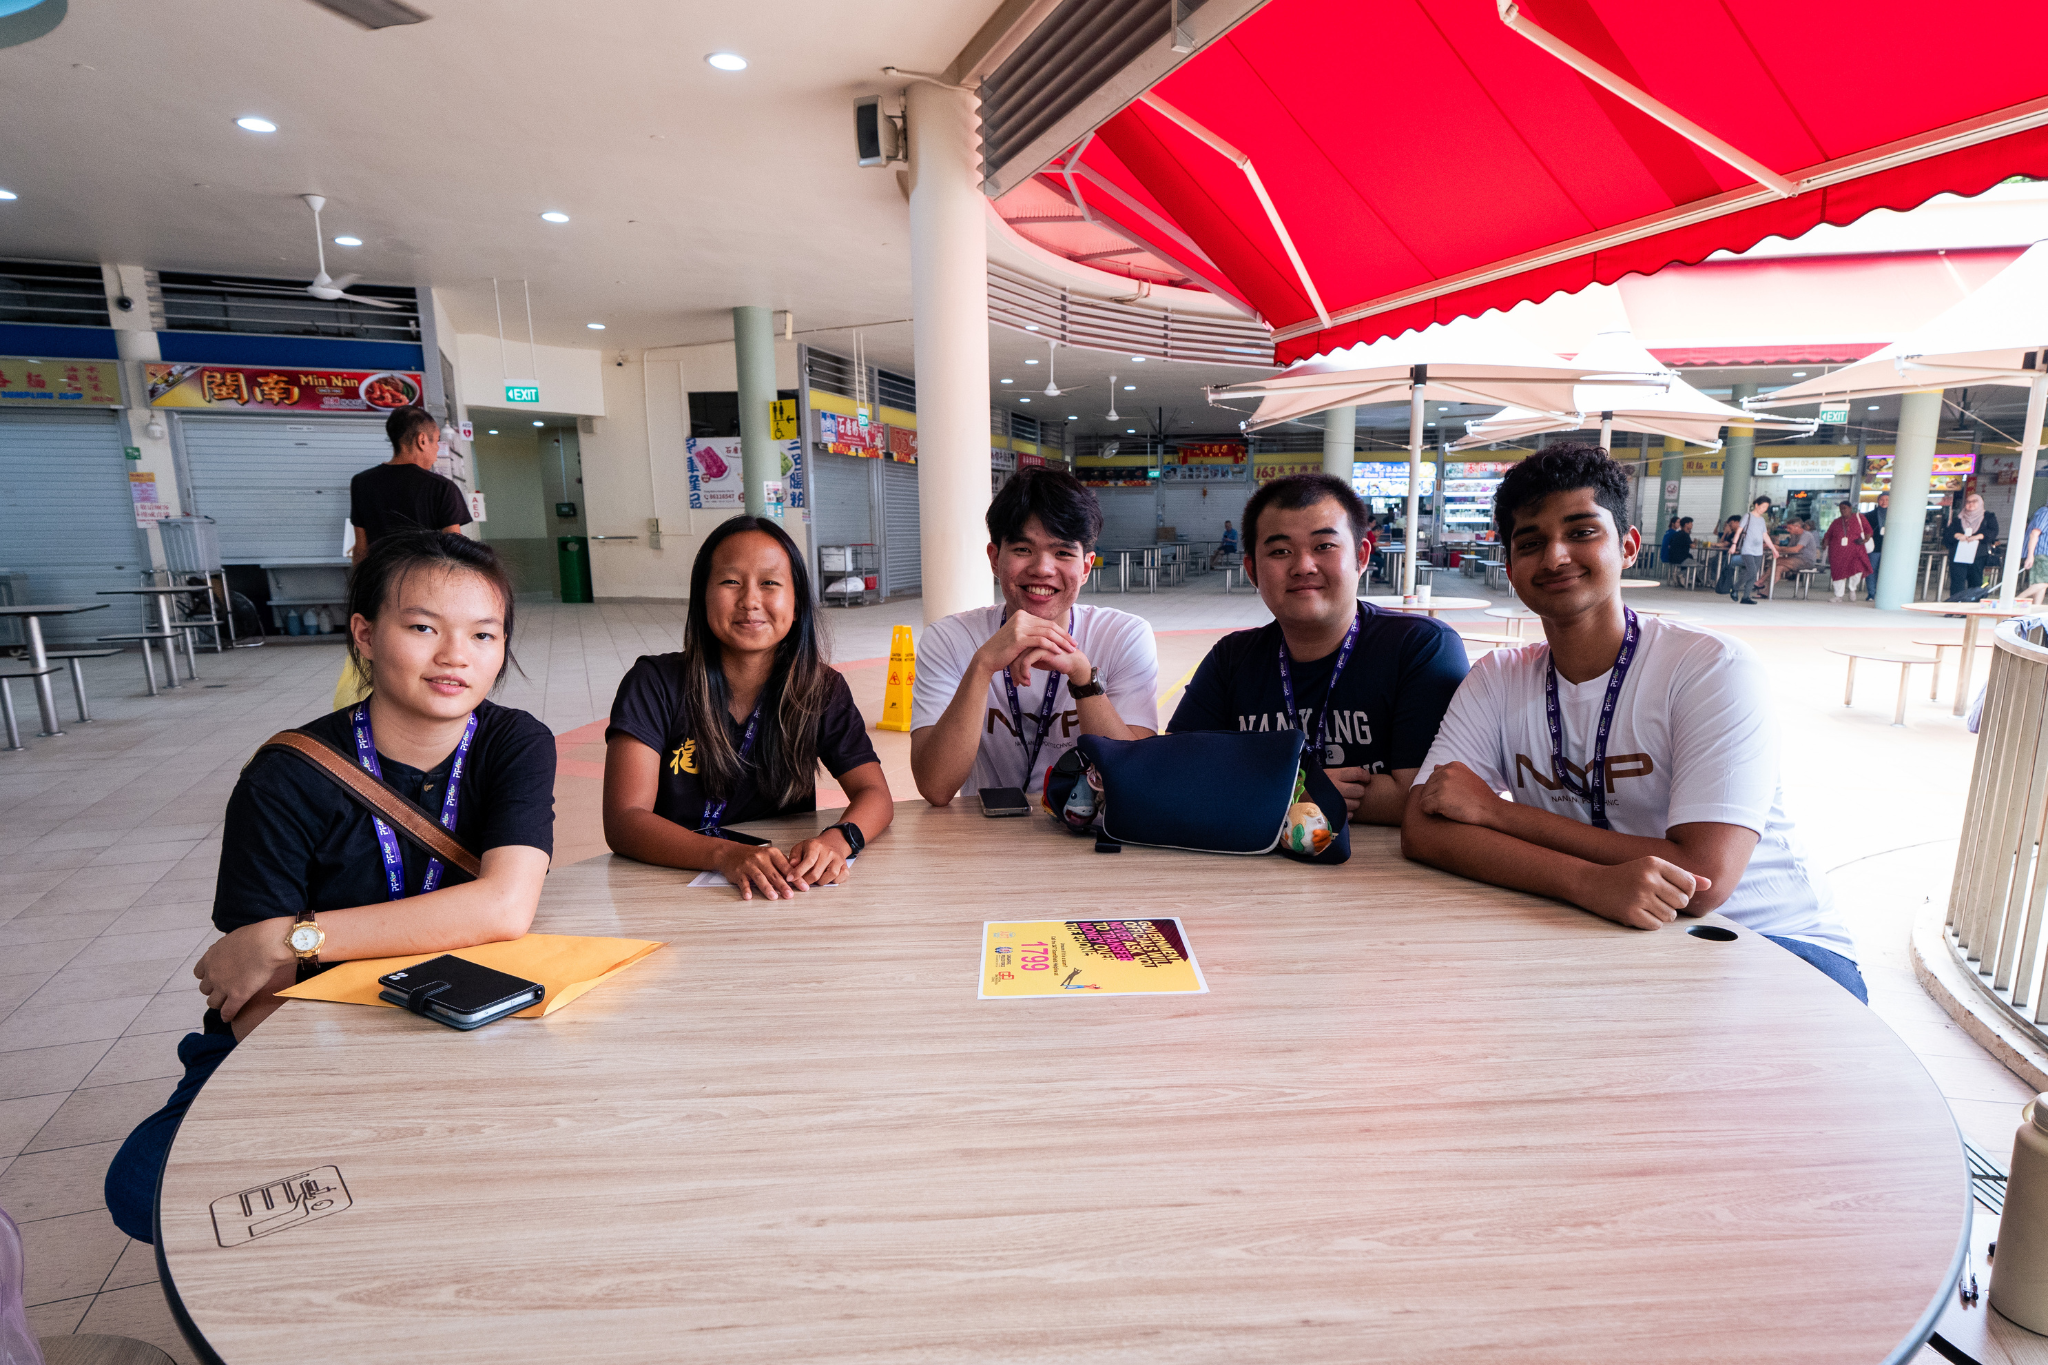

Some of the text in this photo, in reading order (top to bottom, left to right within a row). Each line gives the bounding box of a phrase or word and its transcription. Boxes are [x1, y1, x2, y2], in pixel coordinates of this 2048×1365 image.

[201, 370, 300, 405] 閩南
[299, 374, 359, 388] Min Nan
[514, 388, 537, 401] EXIT
[1827, 411, 1846, 422] EXIT
[1256, 466, 1276, 479] 163
[472, 496, 480, 518] AED
[1515, 752, 1654, 793] NYP
[1064, 923, 1081, 934] THE
[1078, 922, 1116, 961] MONEY OVER
[1092, 922, 1134, 961] TO TRANSFER
[1122, 921, 1158, 950] OFFICIALS
[1137, 920, 1182, 961] GOVERNMENT
[1020, 941, 1049, 971] 1799
[1107, 921, 1156, 968] NEVER ASK YOU
